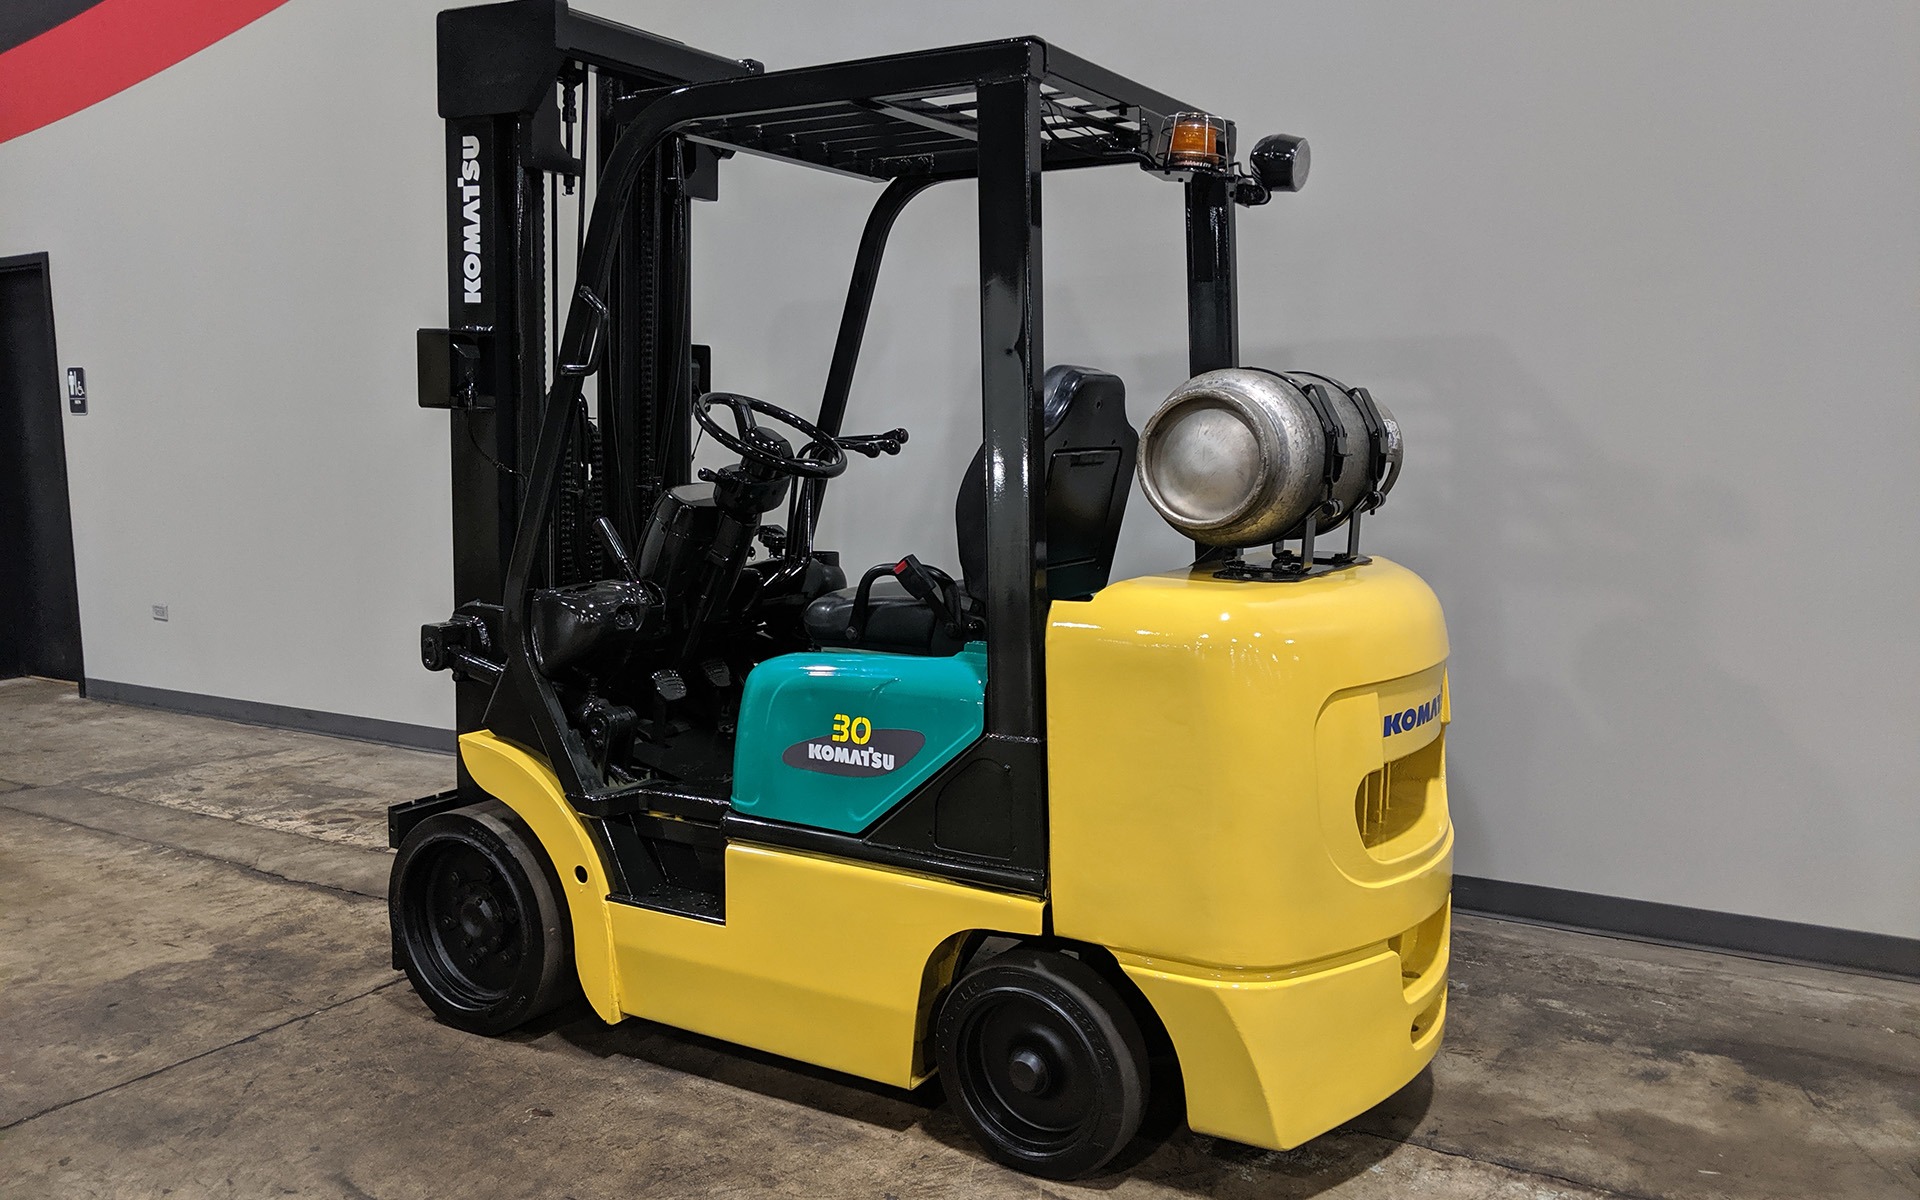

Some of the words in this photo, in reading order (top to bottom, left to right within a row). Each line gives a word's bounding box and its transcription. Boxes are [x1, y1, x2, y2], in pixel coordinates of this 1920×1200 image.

[457, 135, 482, 304] KOMATSU
[832, 713, 872, 745] 30
[1383, 693, 1442, 738] KOMAT
[808, 743, 895, 771] KOMATSU
